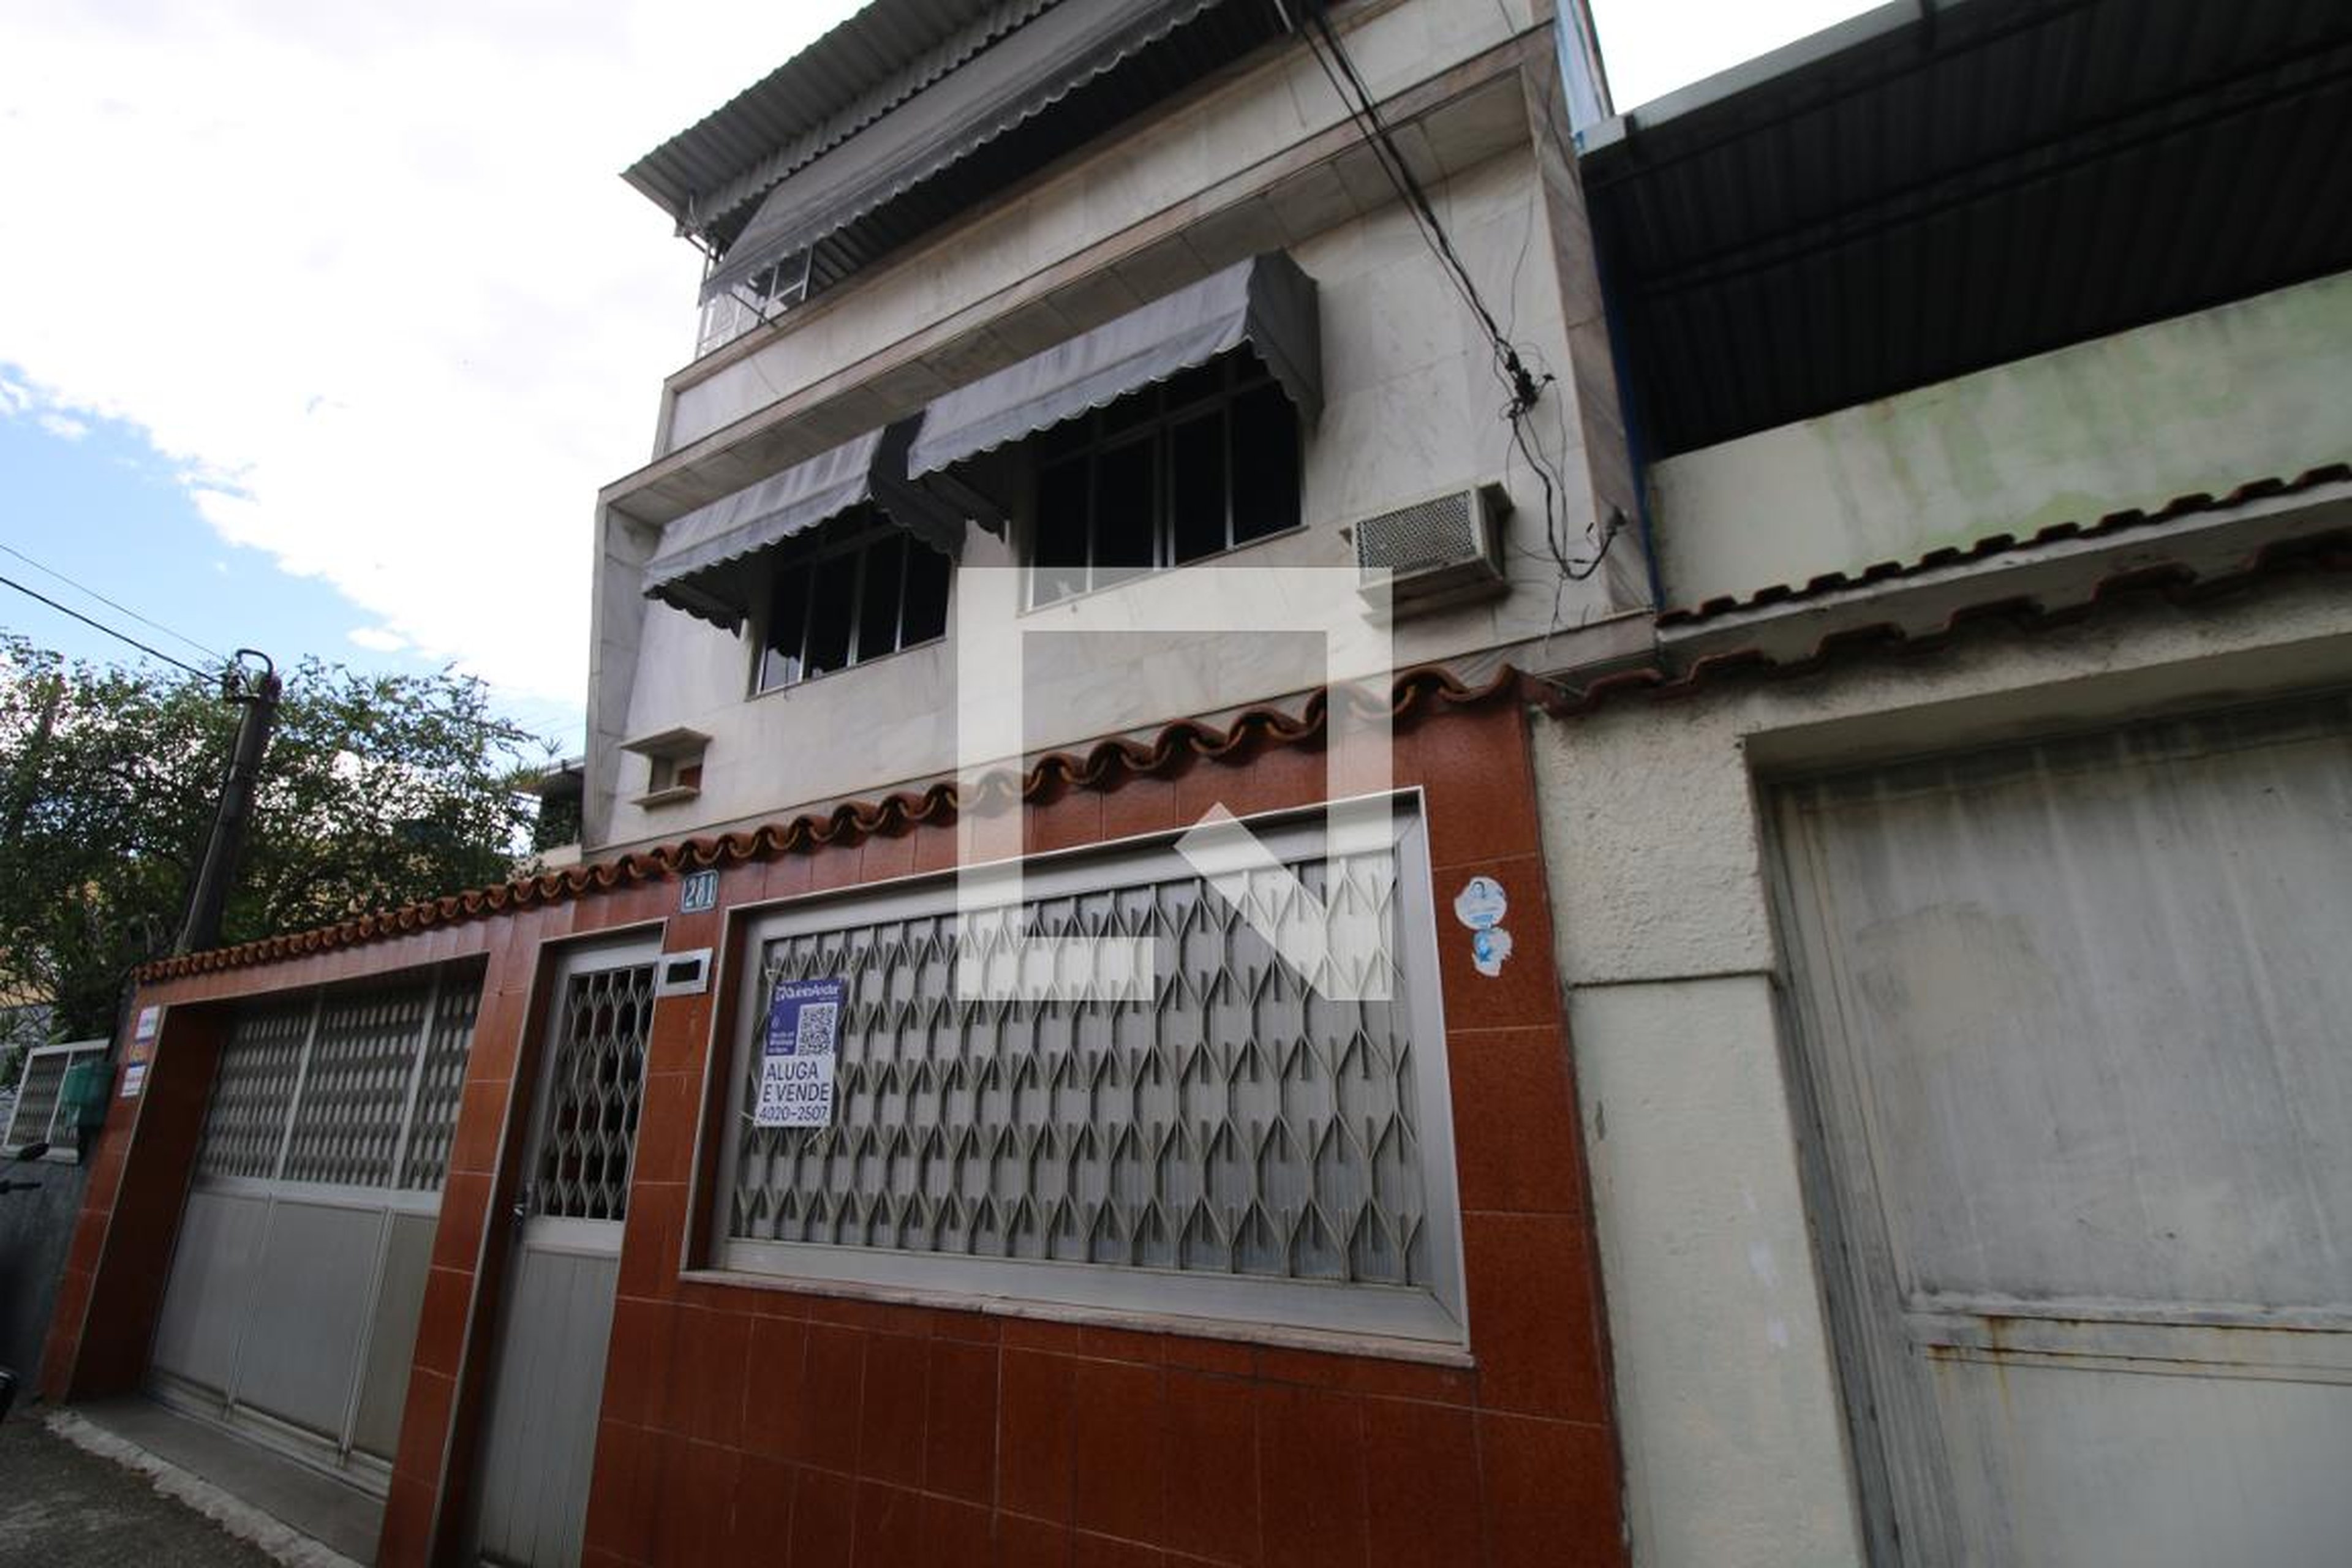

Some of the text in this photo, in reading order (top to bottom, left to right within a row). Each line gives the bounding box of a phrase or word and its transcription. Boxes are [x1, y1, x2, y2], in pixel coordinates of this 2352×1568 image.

[764, 1061, 819, 1081] ALUGA
[763, 1082, 830, 1102] E VENDE
